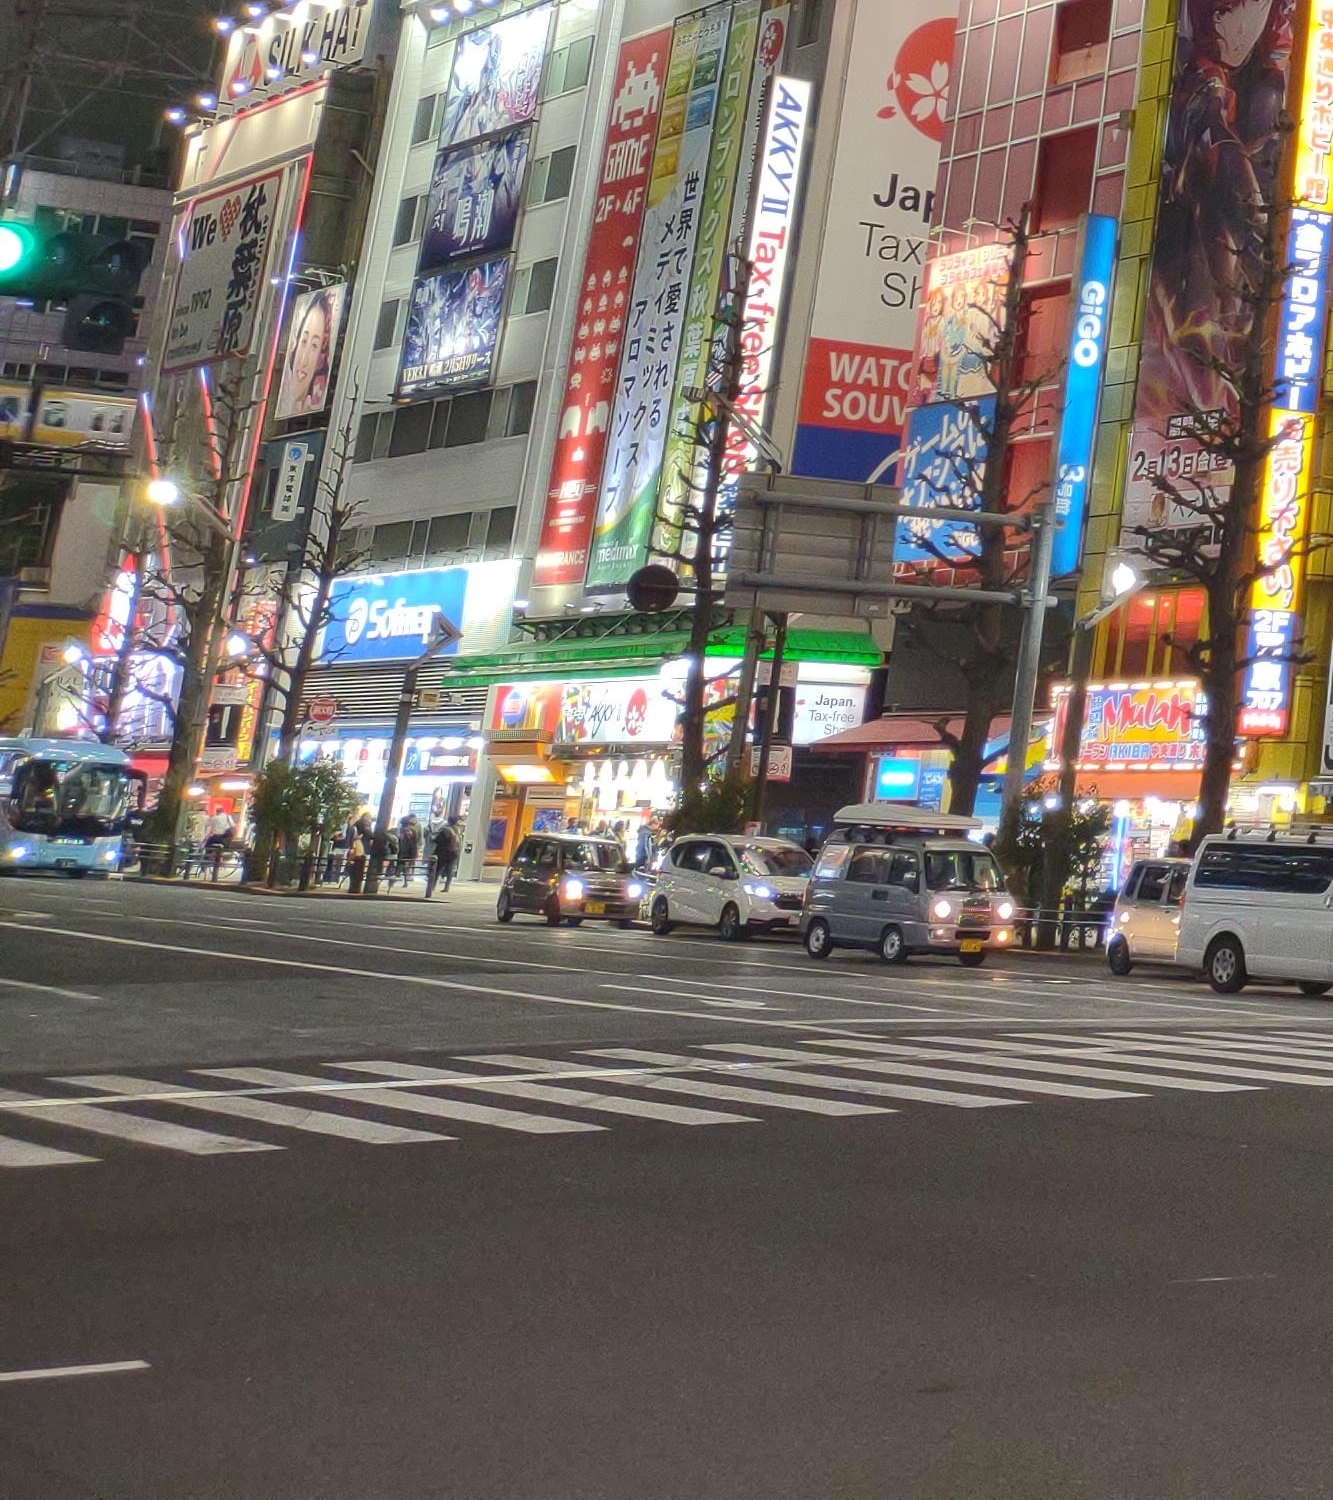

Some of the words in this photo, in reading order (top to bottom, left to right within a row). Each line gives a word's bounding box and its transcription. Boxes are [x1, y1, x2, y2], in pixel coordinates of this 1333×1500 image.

[267, 26, 316, 88] SILK
[318, 1, 371, 65] HAT
[603, 134, 650, 186] GAME
[696, 40, 744, 279] メロンブックス
[767, 83, 804, 193] AKKY
[594, 197, 614, 225] 2F
[622, 186, 643, 217] 4F
[1253, 609, 1292, 633] 2F
[808, 709, 856, 724] Tax-free
[815, 695, 857, 710] Japan.
[1102, 692, 1194, 741] Mulan
